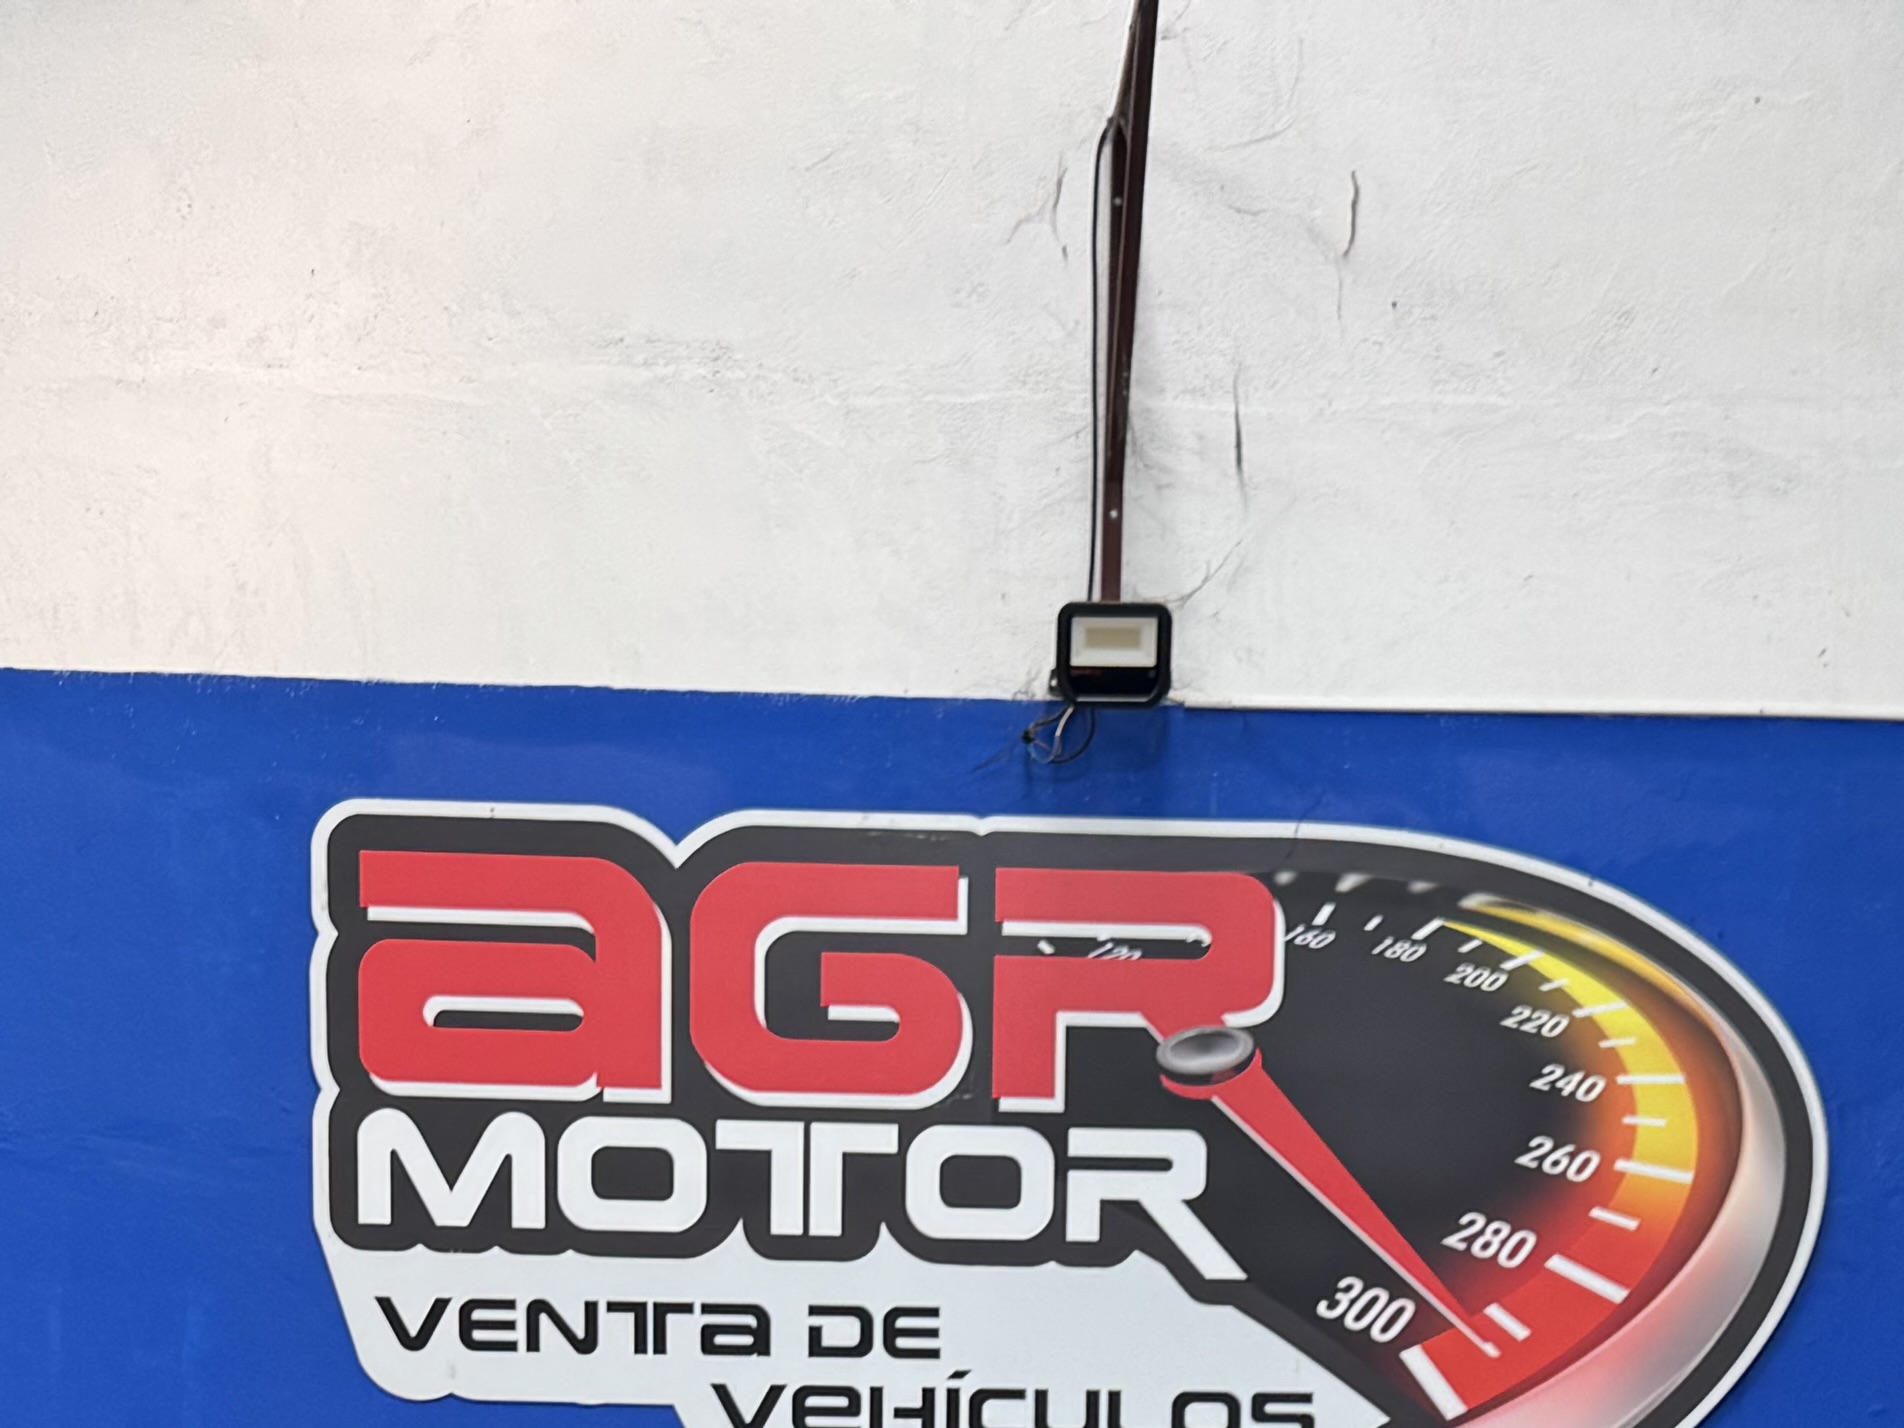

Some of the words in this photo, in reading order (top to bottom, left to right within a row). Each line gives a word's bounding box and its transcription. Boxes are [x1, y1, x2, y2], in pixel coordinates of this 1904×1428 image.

[1285, 924, 1336, 949] 160
[1372, 936, 1427, 962] 180
[1444, 963, 1508, 992] 200
[1500, 1005, 1570, 1038] 220
[1529, 1063, 1607, 1103] 240
[1514, 1136, 1601, 1184] 260
[357, 1108, 1248, 1280] MOTOR
[1442, 1211, 1537, 1270] 280
[1316, 1276, 1416, 1344] 300
[807, 1305, 941, 1360] DE
